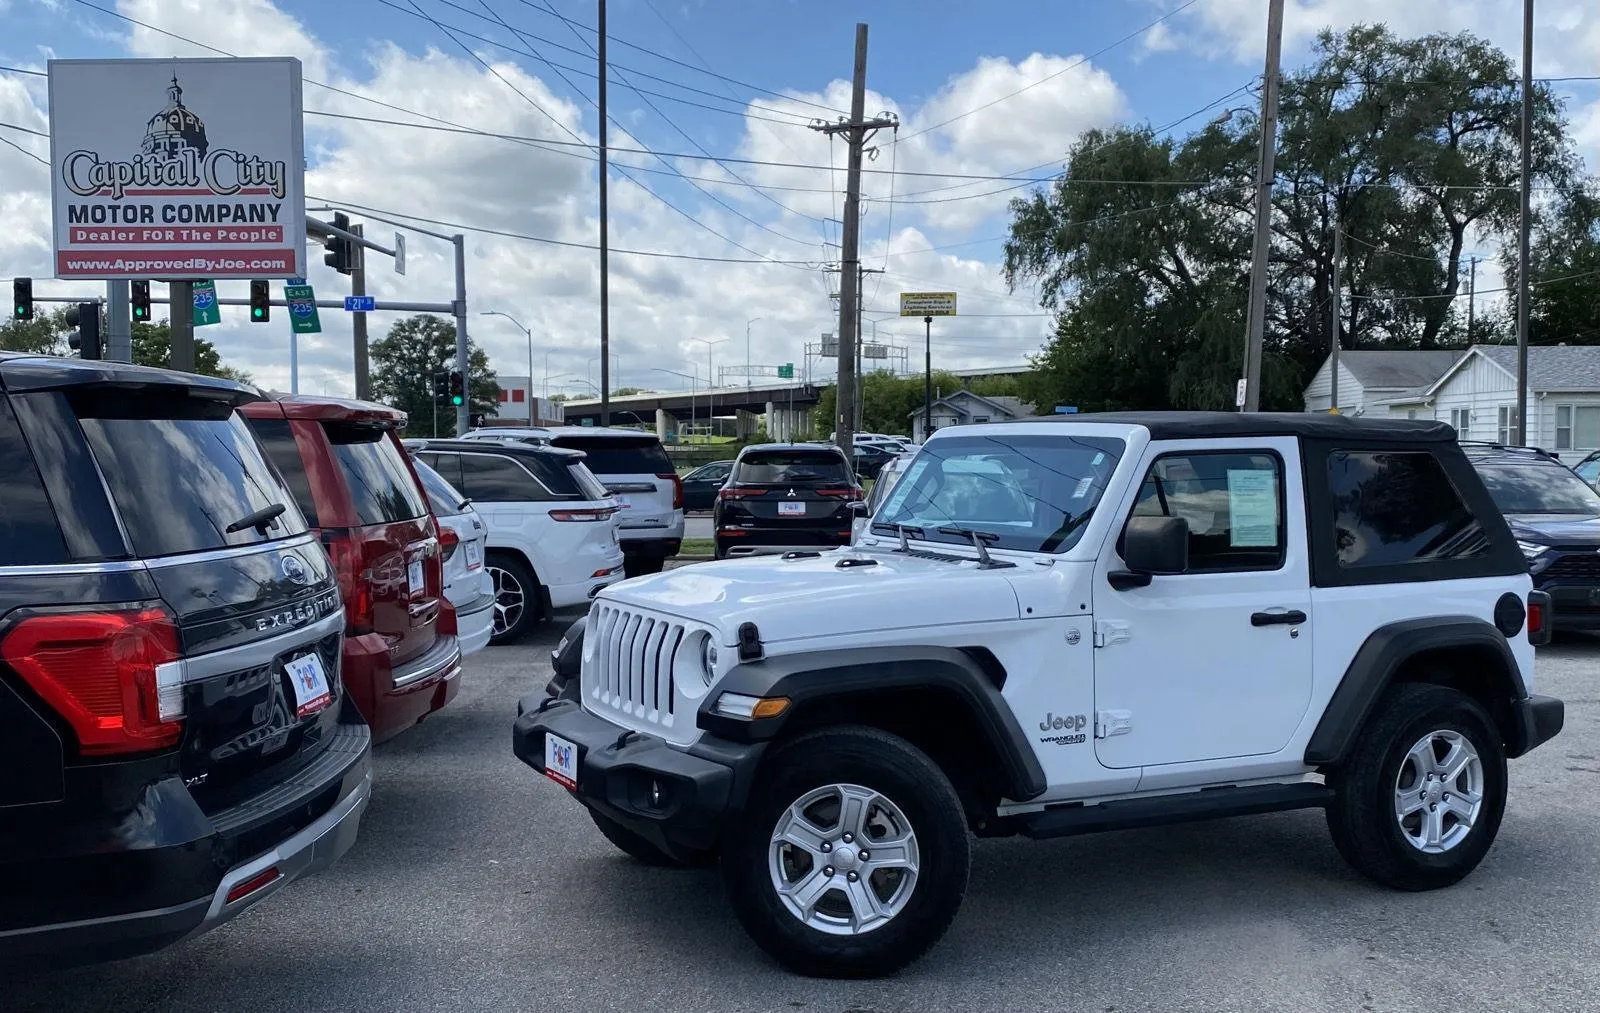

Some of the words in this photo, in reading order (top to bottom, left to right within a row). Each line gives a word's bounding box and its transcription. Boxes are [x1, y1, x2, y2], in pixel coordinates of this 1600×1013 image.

[62, 149, 200, 201] Capital
[204, 148, 286, 200] City
[68, 204, 154, 224] MOTOR
[162, 203, 282, 223] COMPANY
[76, 230, 135, 241] Dealer
[142, 230, 175, 241] FOR
[180, 230, 212, 240] The
[217, 230, 277, 243] People
[67, 257, 286, 272] www.ApprovedByJoe.com
[193, 293, 212, 304] 235
[292, 303, 313, 313] 235
[1040, 712, 1086, 732] Jeep
[1040, 733, 1086, 743] WRANGLER
